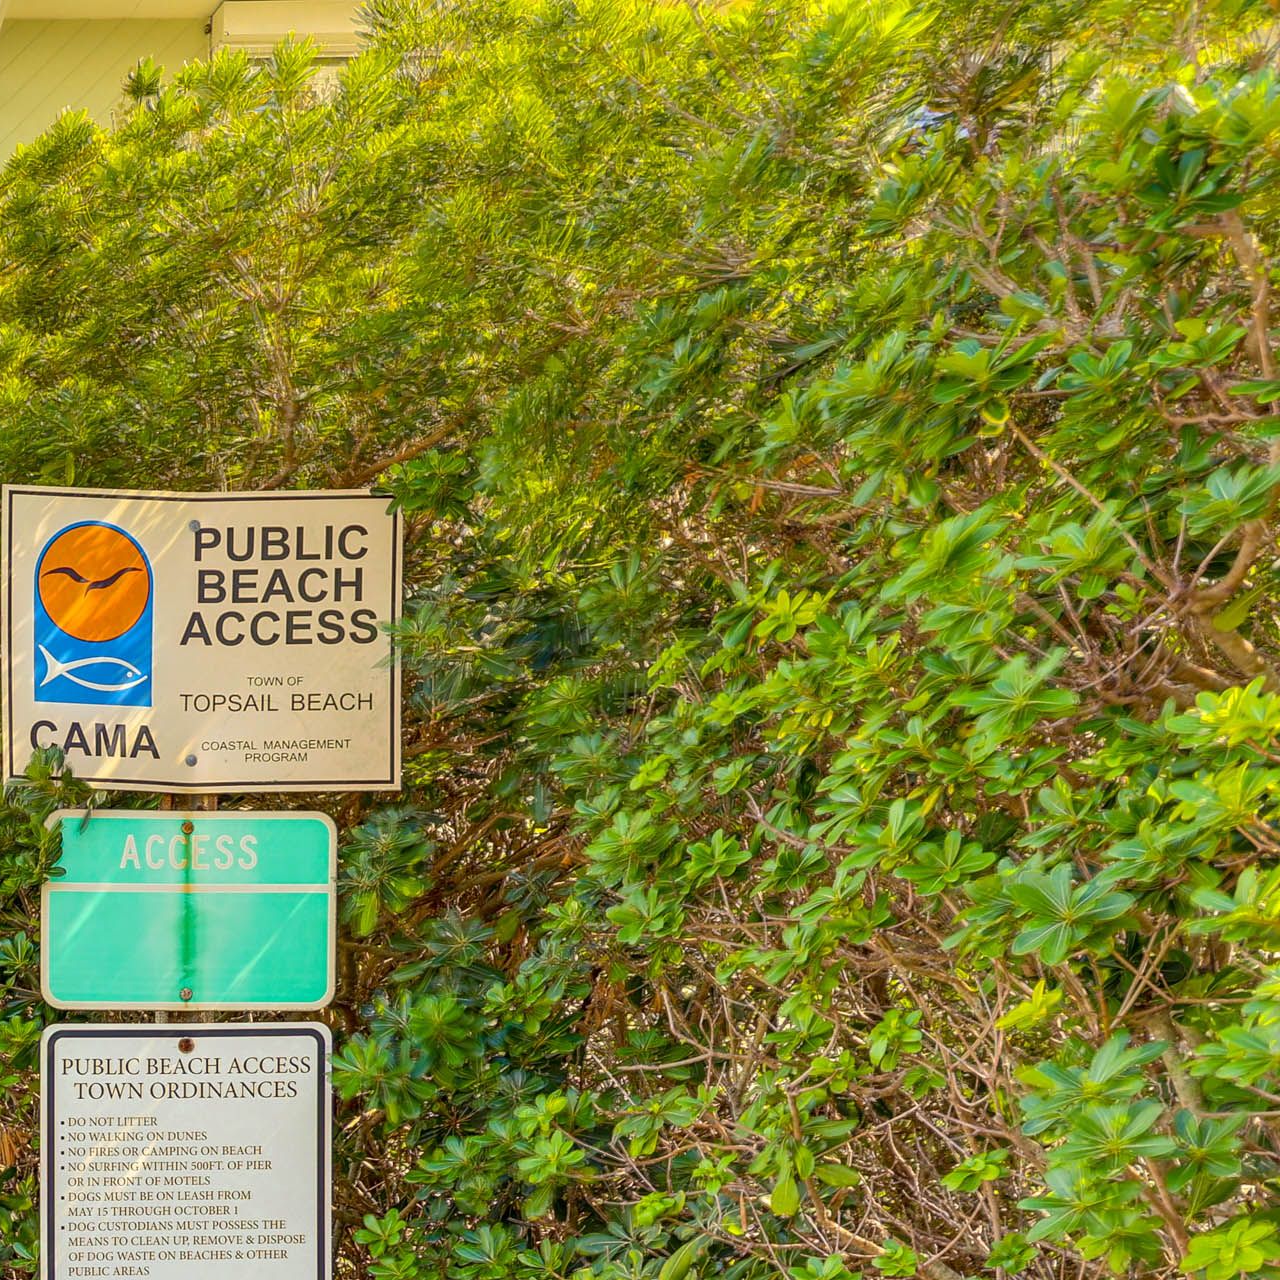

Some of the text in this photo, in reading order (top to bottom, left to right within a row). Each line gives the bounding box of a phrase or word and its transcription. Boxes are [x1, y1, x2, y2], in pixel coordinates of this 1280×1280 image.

[194, 524, 368, 562] PUBLIC
[197, 567, 362, 603] BEACH
[179, 608, 378, 646] ACCESS
[246, 676, 304, 686] TOWN OF
[179, 692, 372, 712] TOPSAIL BEACH
[30, 720, 159, 757] CAMA
[201, 738, 351, 751] COASTAL MANAGEMENT
[244, 752, 307, 762] PROGRAM
[119, 832, 258, 872] ACCESS
[62, 1056, 310, 1075] PUBLIC BEACH ACCESS
[73, 1080, 297, 1099] TOWN ORDINANCES
[67, 1116, 158, 1127] DO NOT LITTER
[67, 1130, 207, 1142] NO WALKING ON DUNES
[68, 1145, 262, 1156] NO FIRES OR CAMPING ON BEACH
[67, 1160, 272, 1172] NO SURFING WITHIN 500FT. OF PIER
[67, 1175, 210, 1186] OR IN FRONT OF MOTELS
[67, 1190, 251, 1201] DOGS MUST BE ON LEASH FROM
